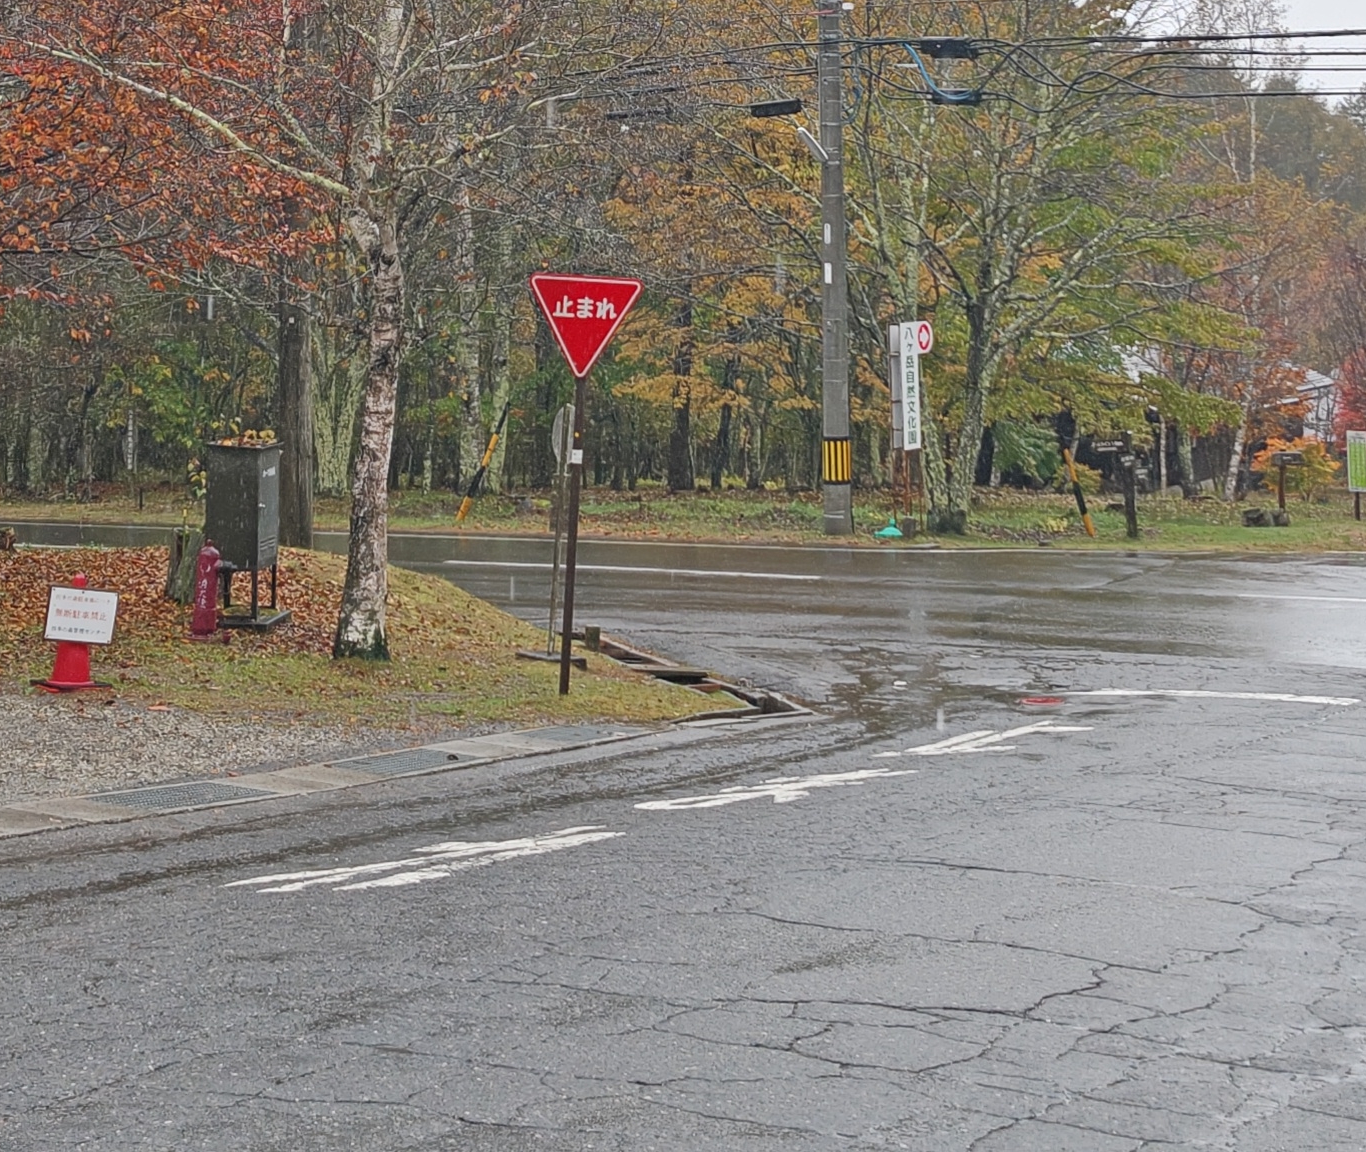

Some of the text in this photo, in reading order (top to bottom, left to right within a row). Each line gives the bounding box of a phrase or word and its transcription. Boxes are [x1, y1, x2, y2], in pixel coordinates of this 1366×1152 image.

[553, 295, 617, 320] 止まれ
[55, 607, 107, 622] 無断駐車禁止
